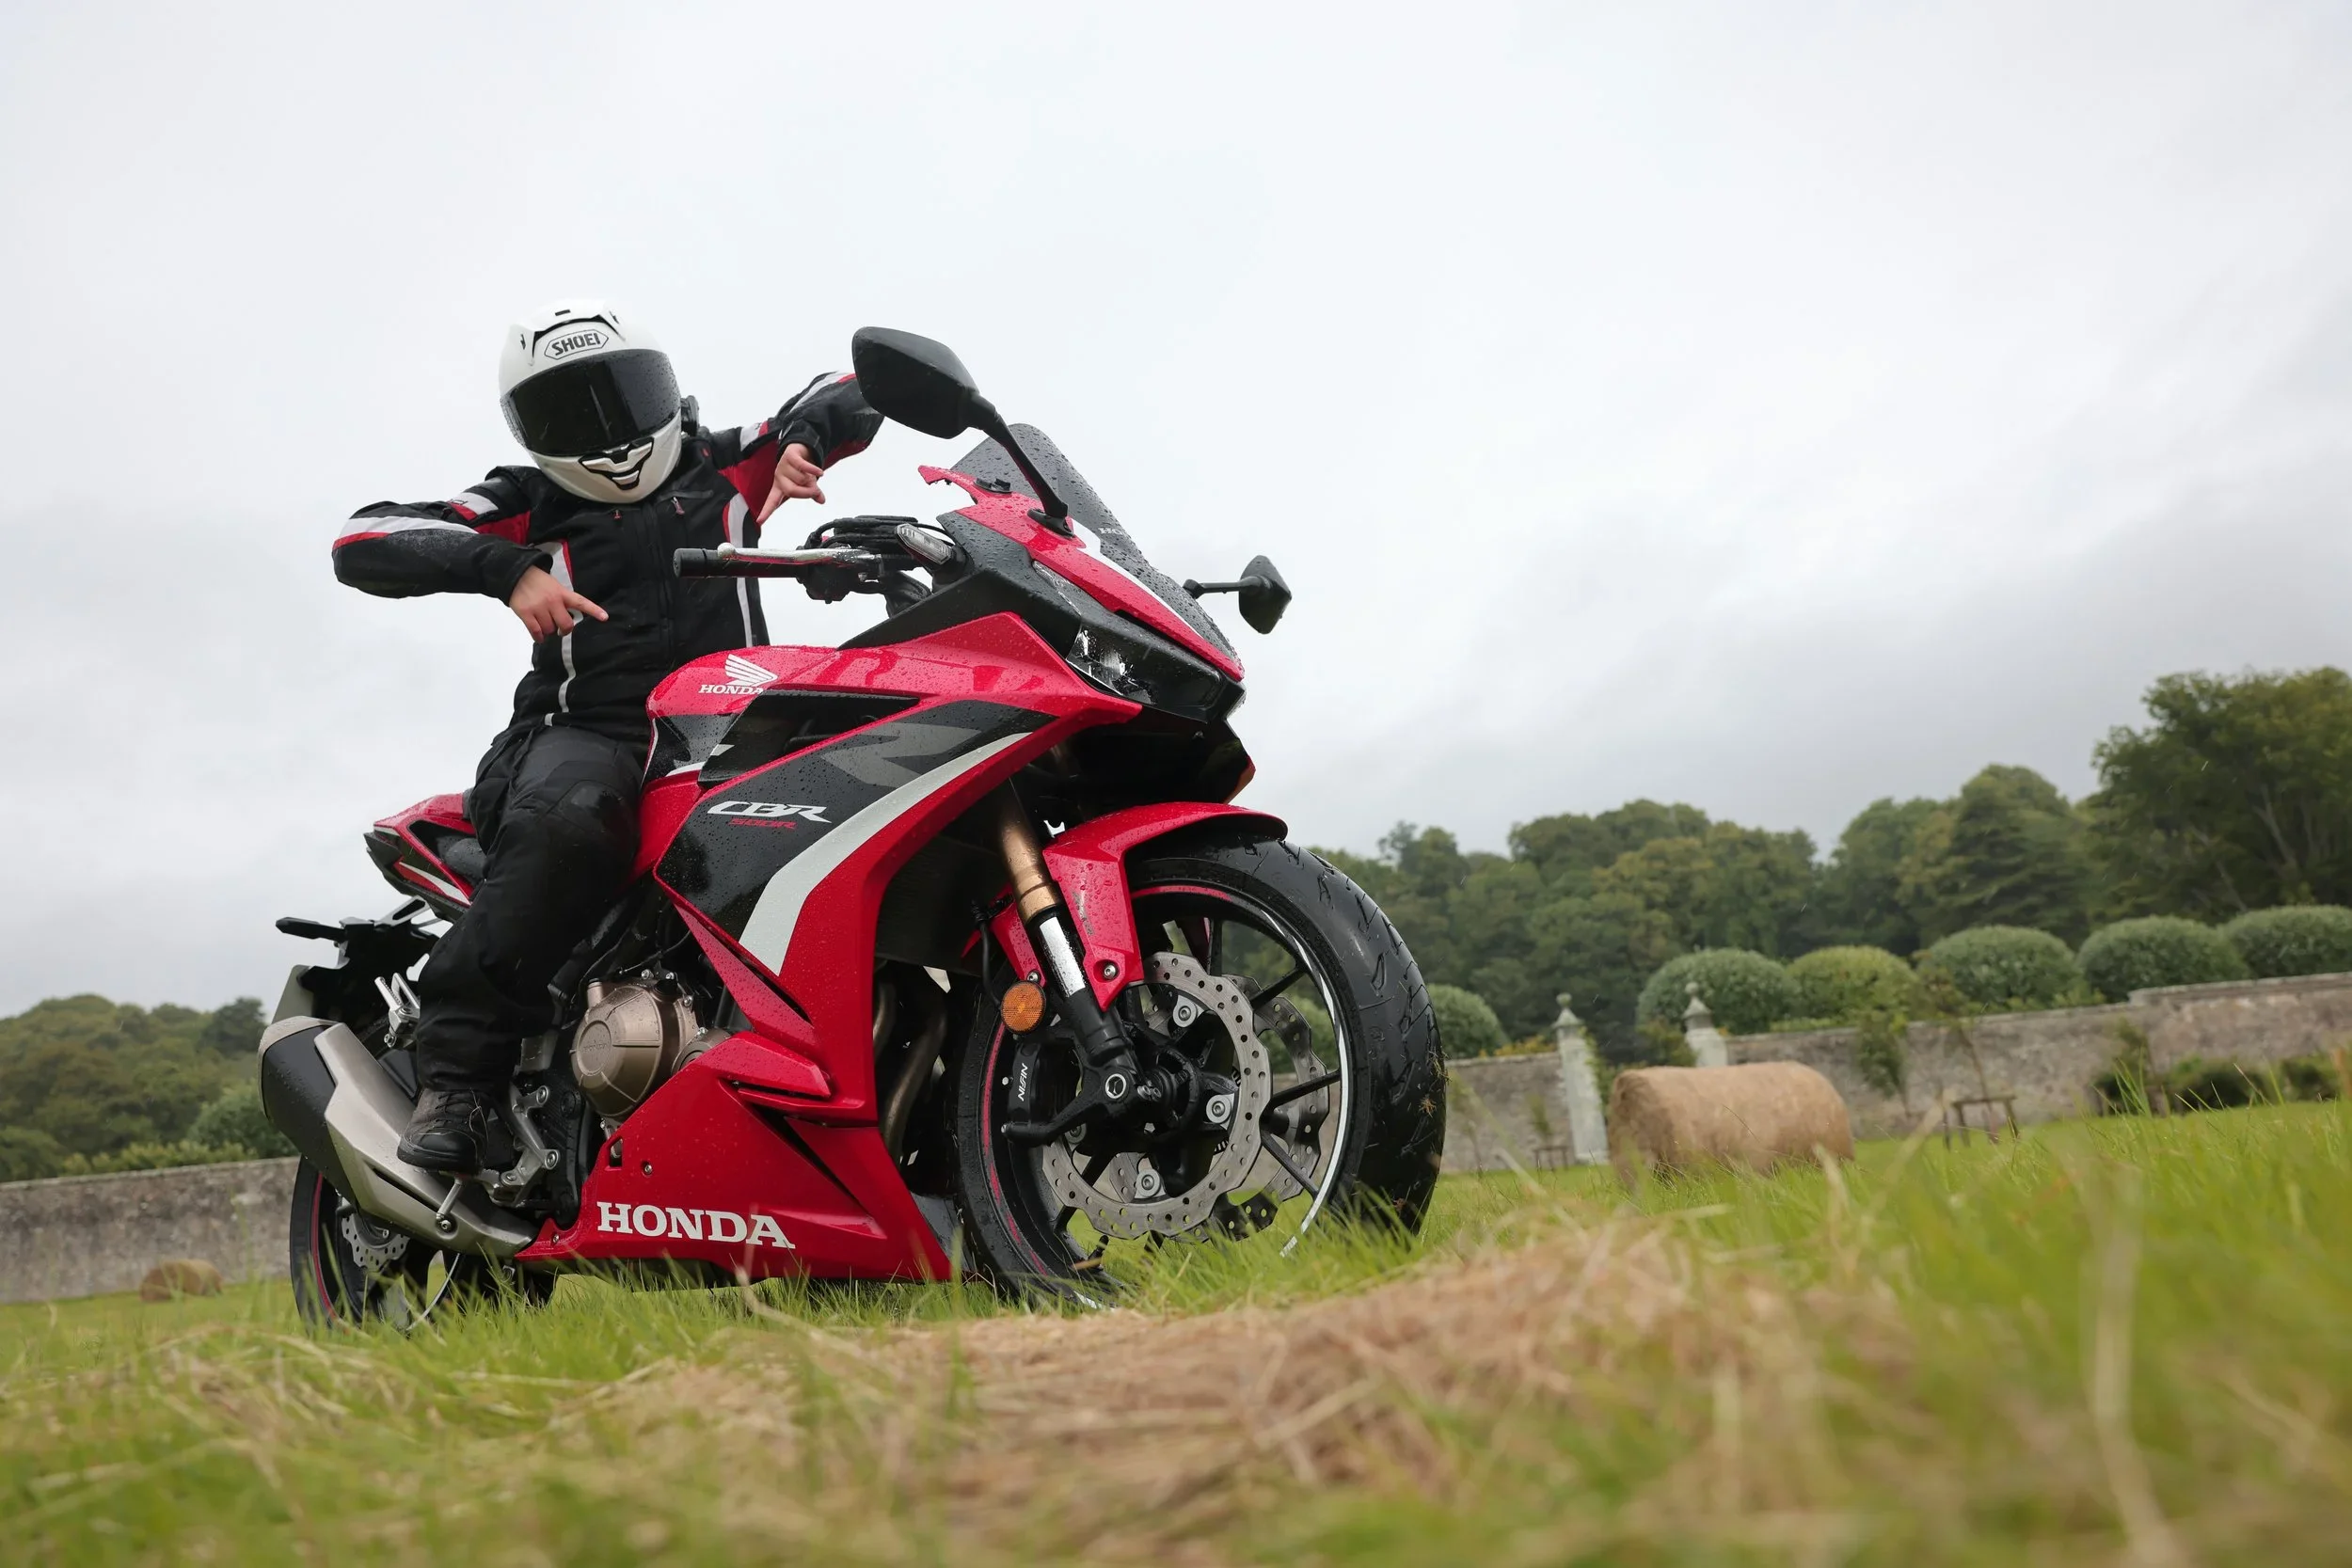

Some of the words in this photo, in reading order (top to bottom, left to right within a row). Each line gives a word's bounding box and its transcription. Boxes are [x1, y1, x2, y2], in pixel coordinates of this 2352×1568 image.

[551, 332, 601, 356] SHOEI
[698, 684, 765, 695] HONDA
[707, 800, 833, 824] CBR
[596, 1201, 796, 1249] HONDA
